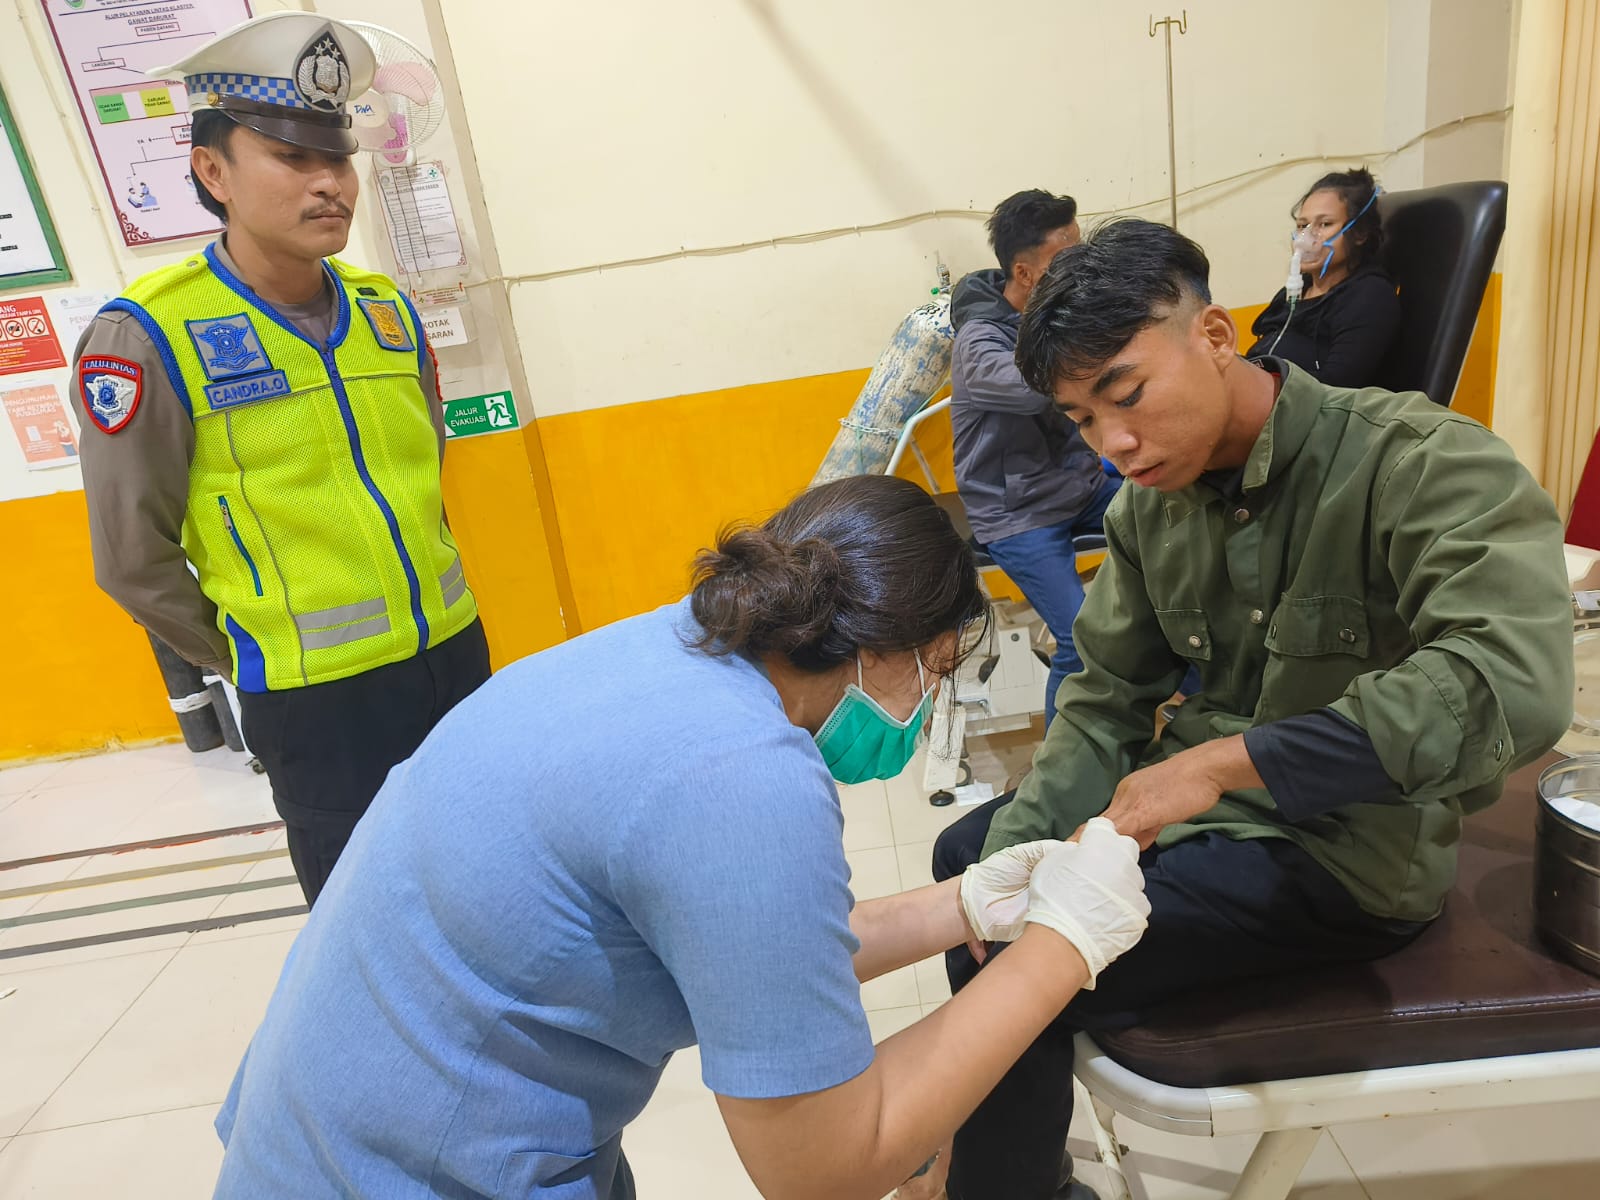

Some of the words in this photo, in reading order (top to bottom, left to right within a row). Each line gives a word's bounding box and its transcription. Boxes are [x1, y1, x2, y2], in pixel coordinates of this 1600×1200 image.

[423, 318, 450, 329] KOTAK
[427, 329, 454, 341] SARAN
[454, 407, 478, 417] JALUR
[450, 415, 487, 427] EVAKUASI
